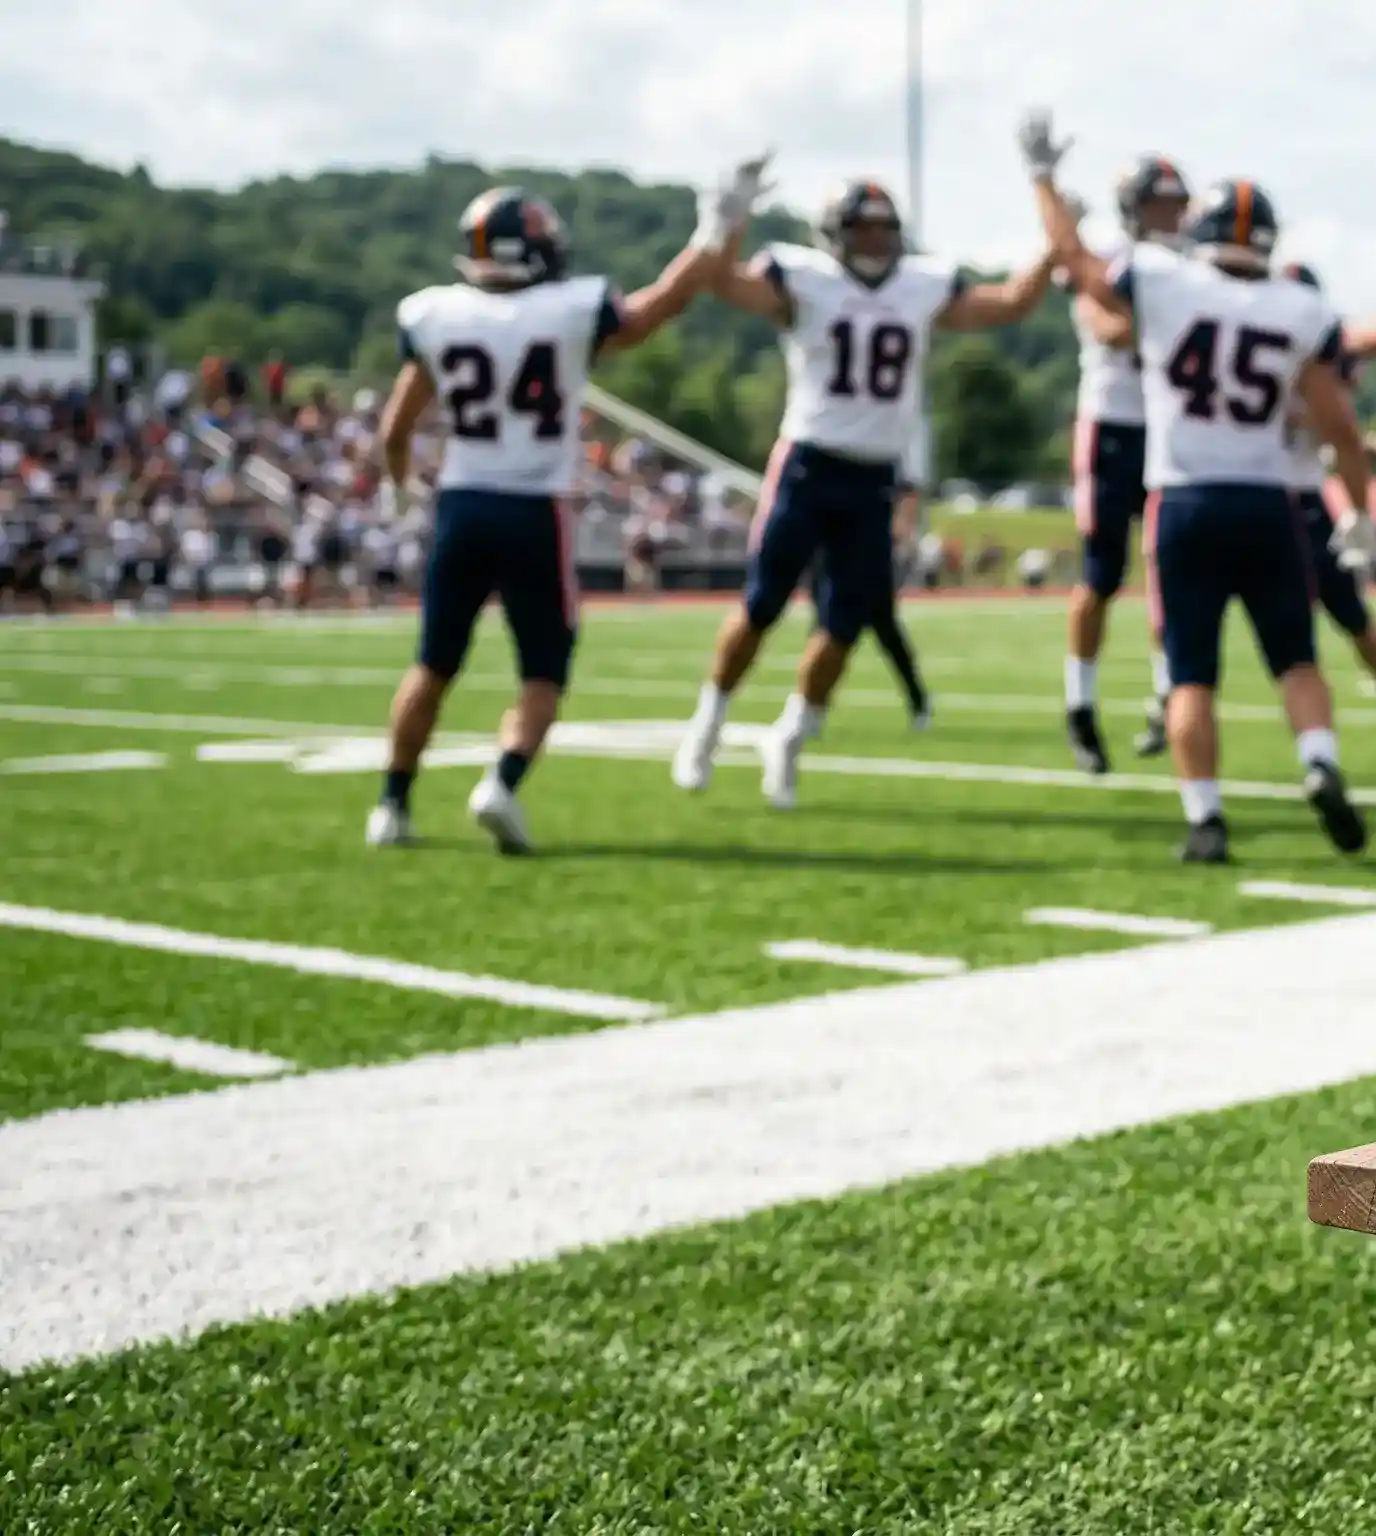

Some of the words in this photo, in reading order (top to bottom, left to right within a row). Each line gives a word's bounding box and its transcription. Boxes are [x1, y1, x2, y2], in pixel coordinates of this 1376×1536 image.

[439, 340, 565, 440] 24
[827, 318, 912, 400] 18
[1167, 319, 1293, 425] 45
